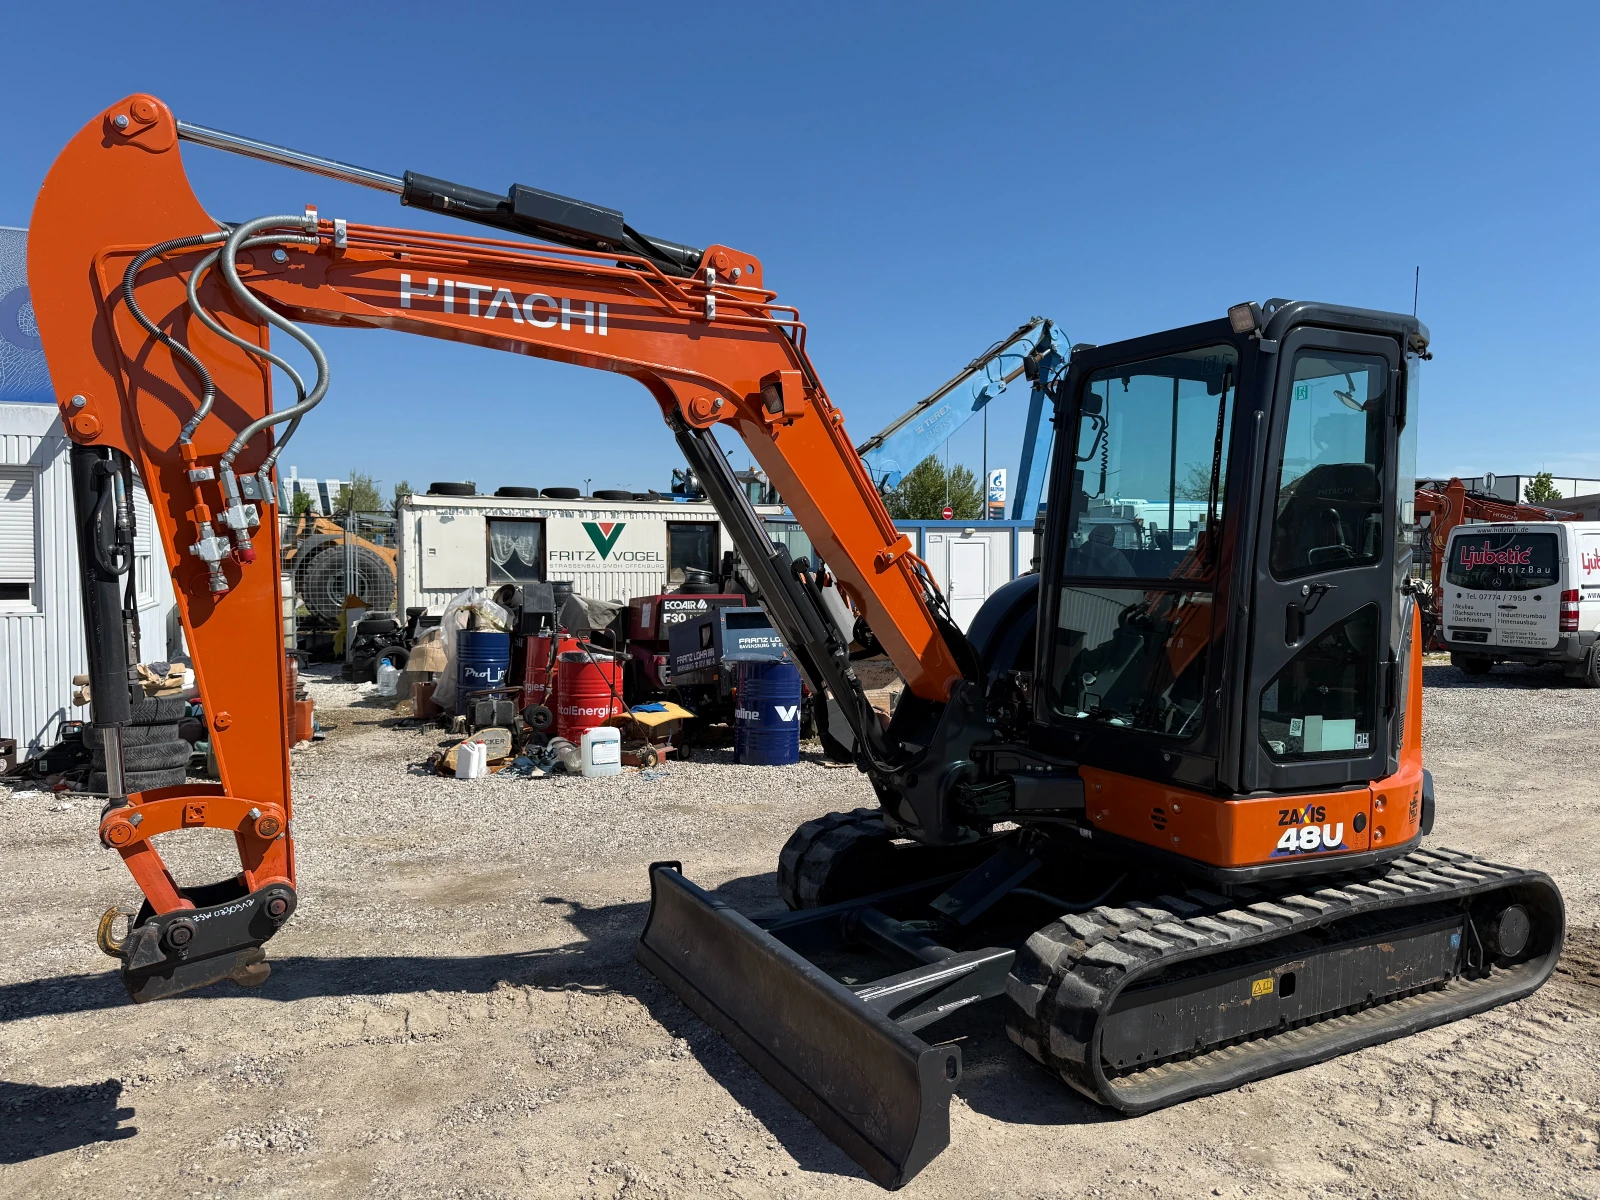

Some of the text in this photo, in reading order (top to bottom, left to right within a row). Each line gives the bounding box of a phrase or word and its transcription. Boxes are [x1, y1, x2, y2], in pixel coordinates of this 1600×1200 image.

[400, 273, 608, 336] HITACHI
[924, 403, 952, 427] TEREX
[1492, 512, 1519, 521] HITACHI
[549, 550, 665, 562] FRITZ VOGEL
[1460, 541, 1533, 570] Ljubetić
[664, 600, 697, 610] ECOAIR
[663, 613, 687, 624] F30
[1278, 803, 1326, 826] ZAXIS
[1276, 822, 1344, 852] 48U
